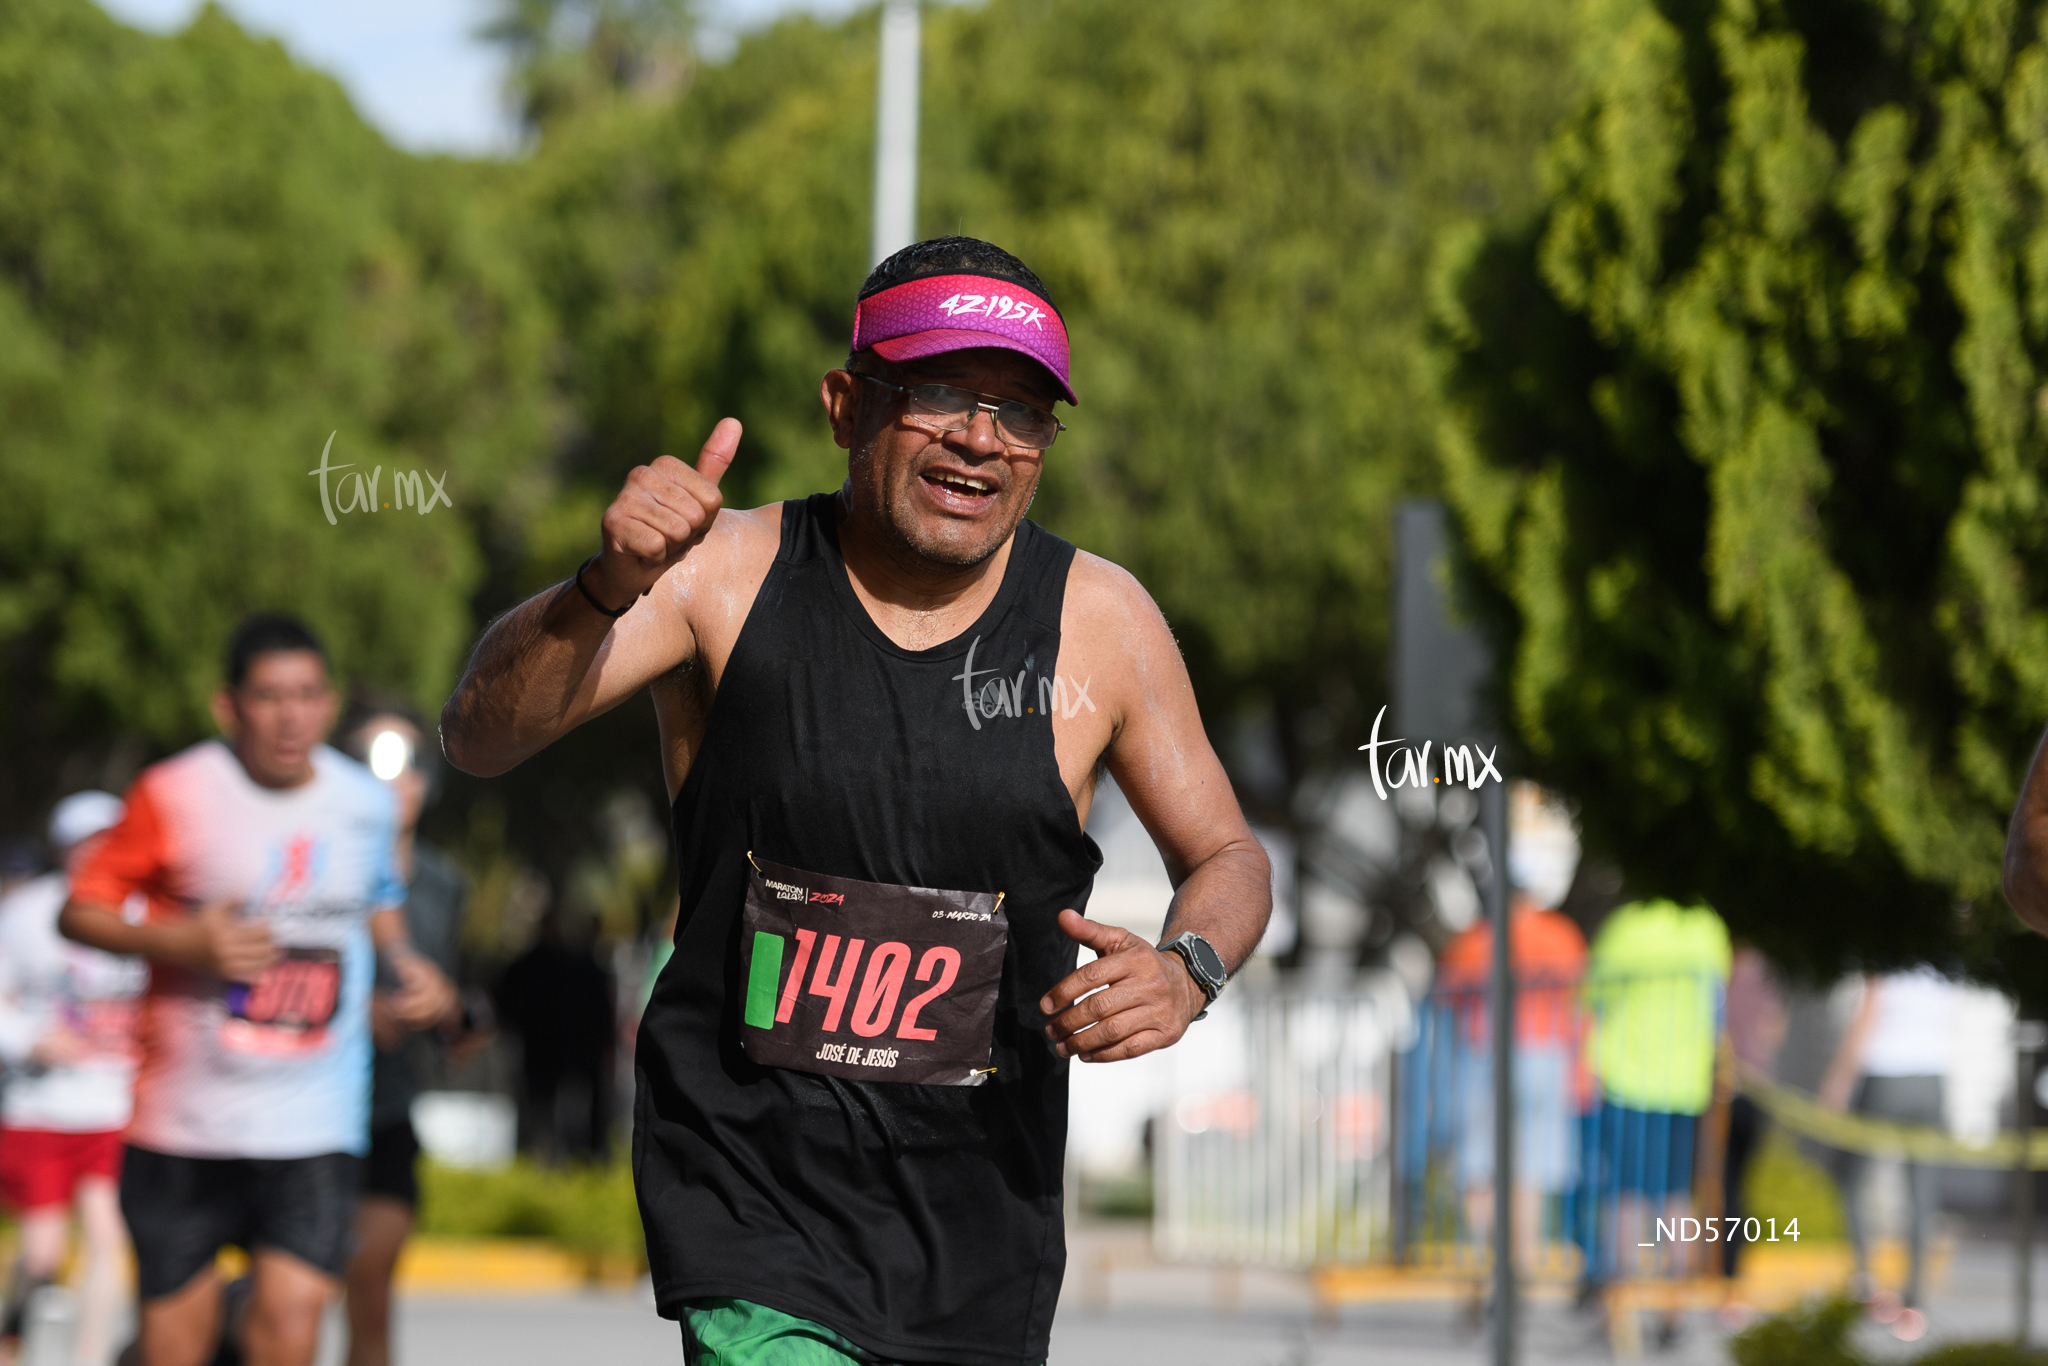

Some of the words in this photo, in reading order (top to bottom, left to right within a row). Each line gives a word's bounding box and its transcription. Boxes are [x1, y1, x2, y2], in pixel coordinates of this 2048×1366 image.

[765, 879, 803, 895] MARATÓN
[775, 928, 961, 1041] 1402
[815, 1043, 847, 1063] JOSÉ
[845, 1046, 863, 1065] DE
[861, 1047, 899, 1068] JESÚS
